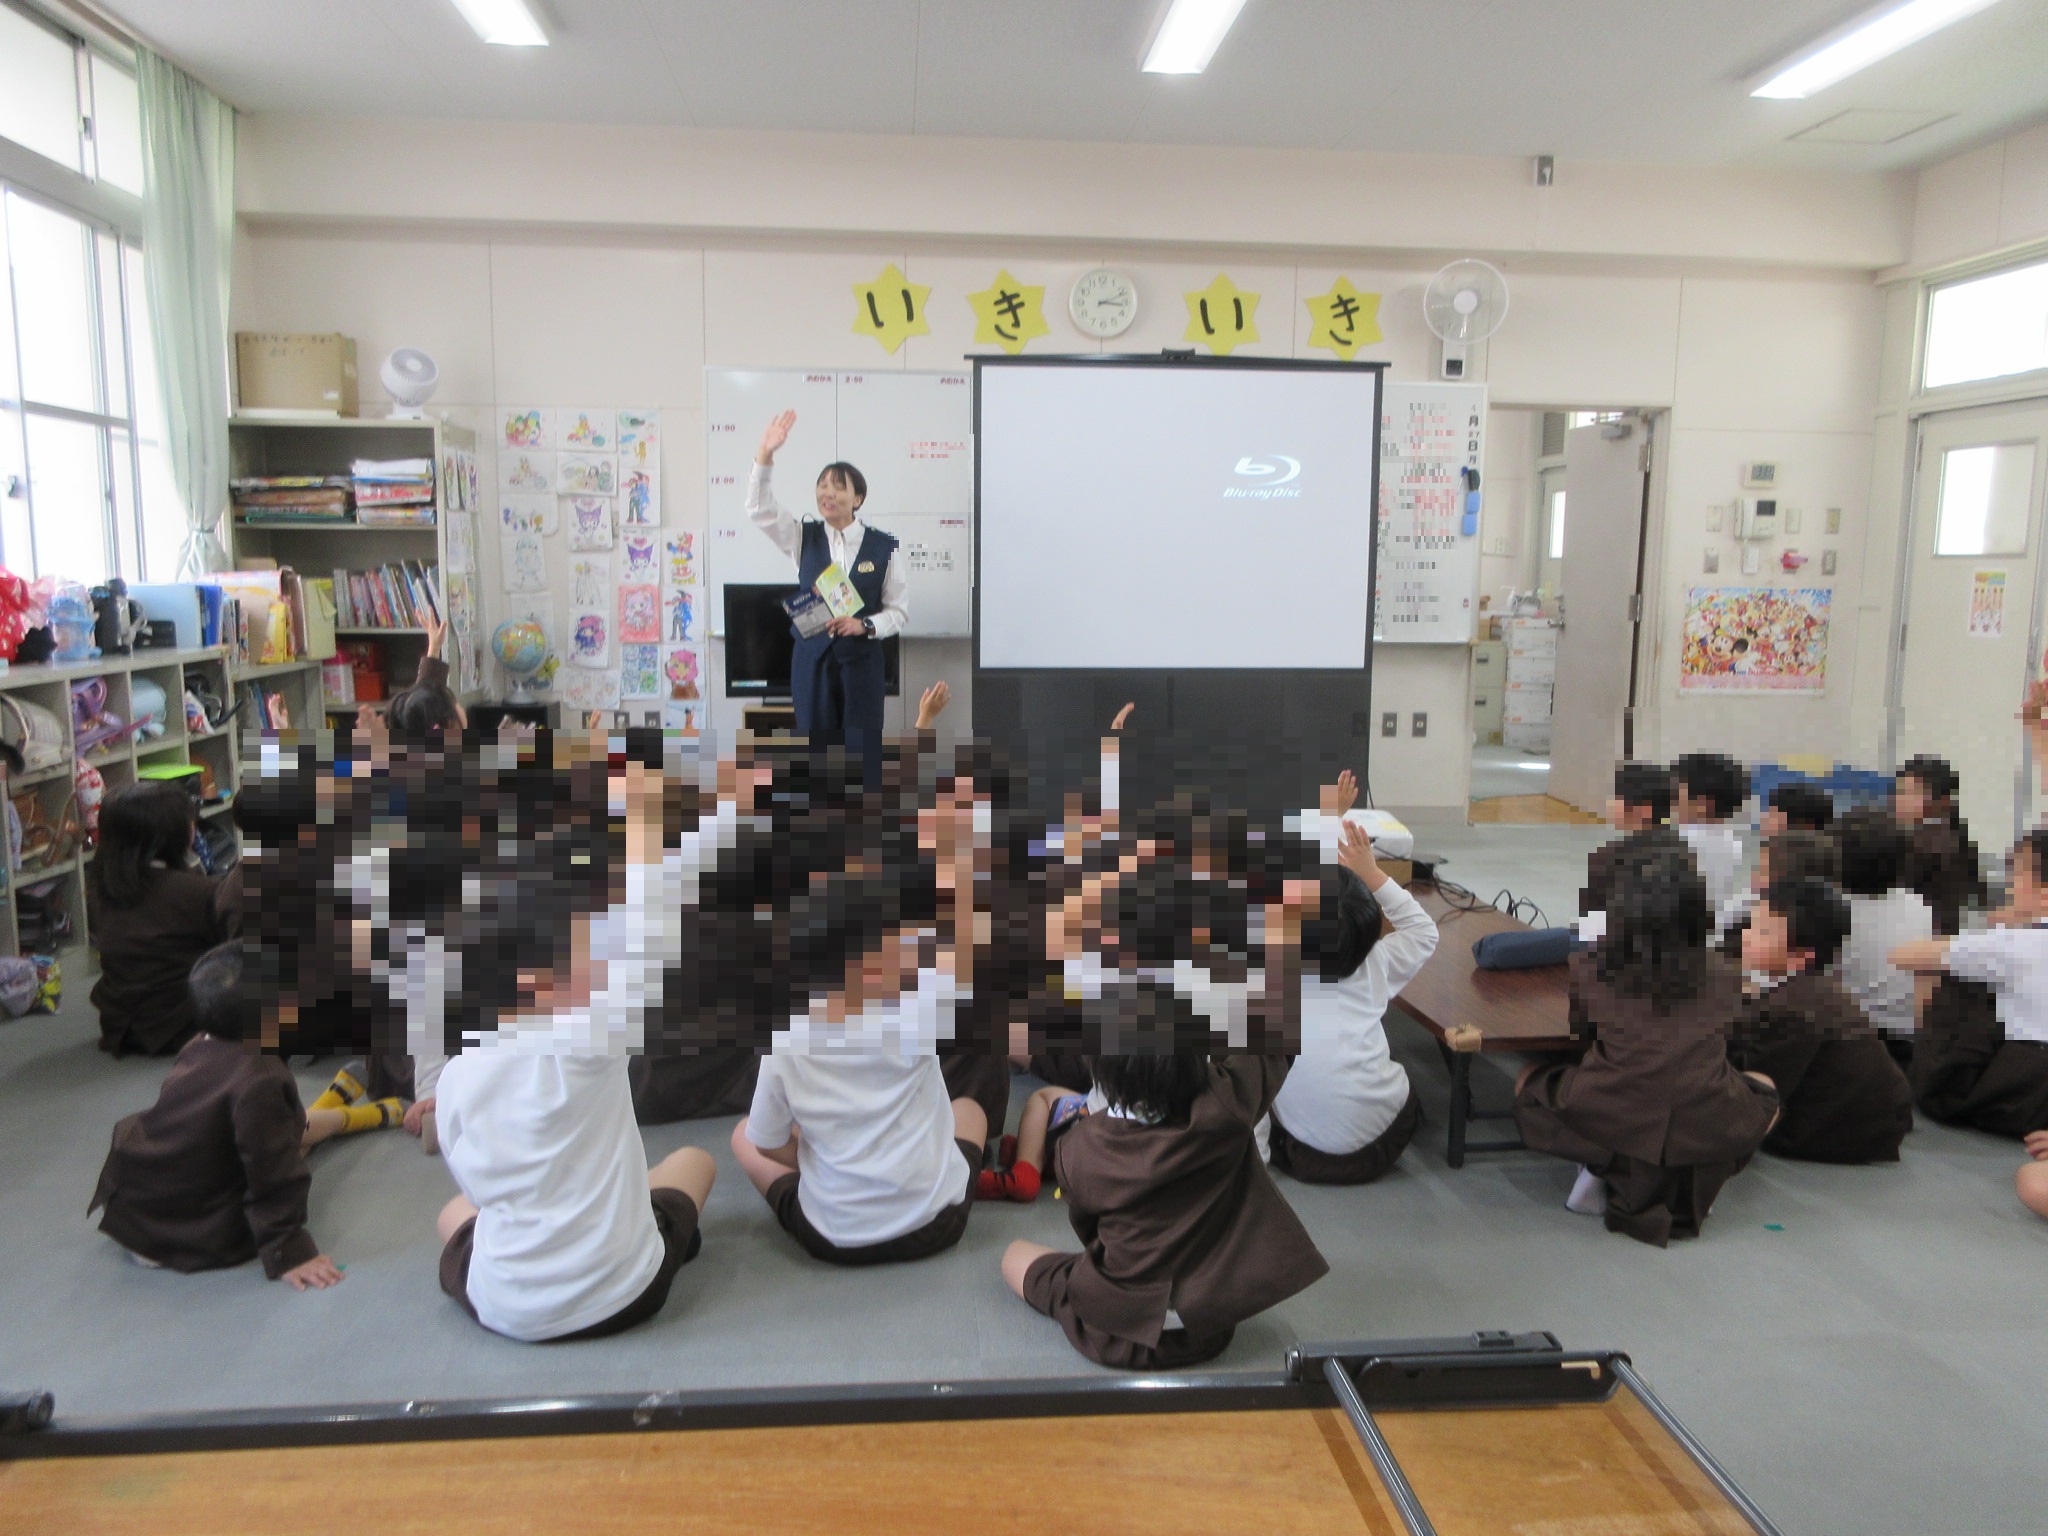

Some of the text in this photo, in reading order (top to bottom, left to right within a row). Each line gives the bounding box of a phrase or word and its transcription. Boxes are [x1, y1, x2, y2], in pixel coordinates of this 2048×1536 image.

[866, 288, 1360, 346] い き い き
[711, 424, 736, 432] 11:00
[711, 477, 735, 485] 12:00
